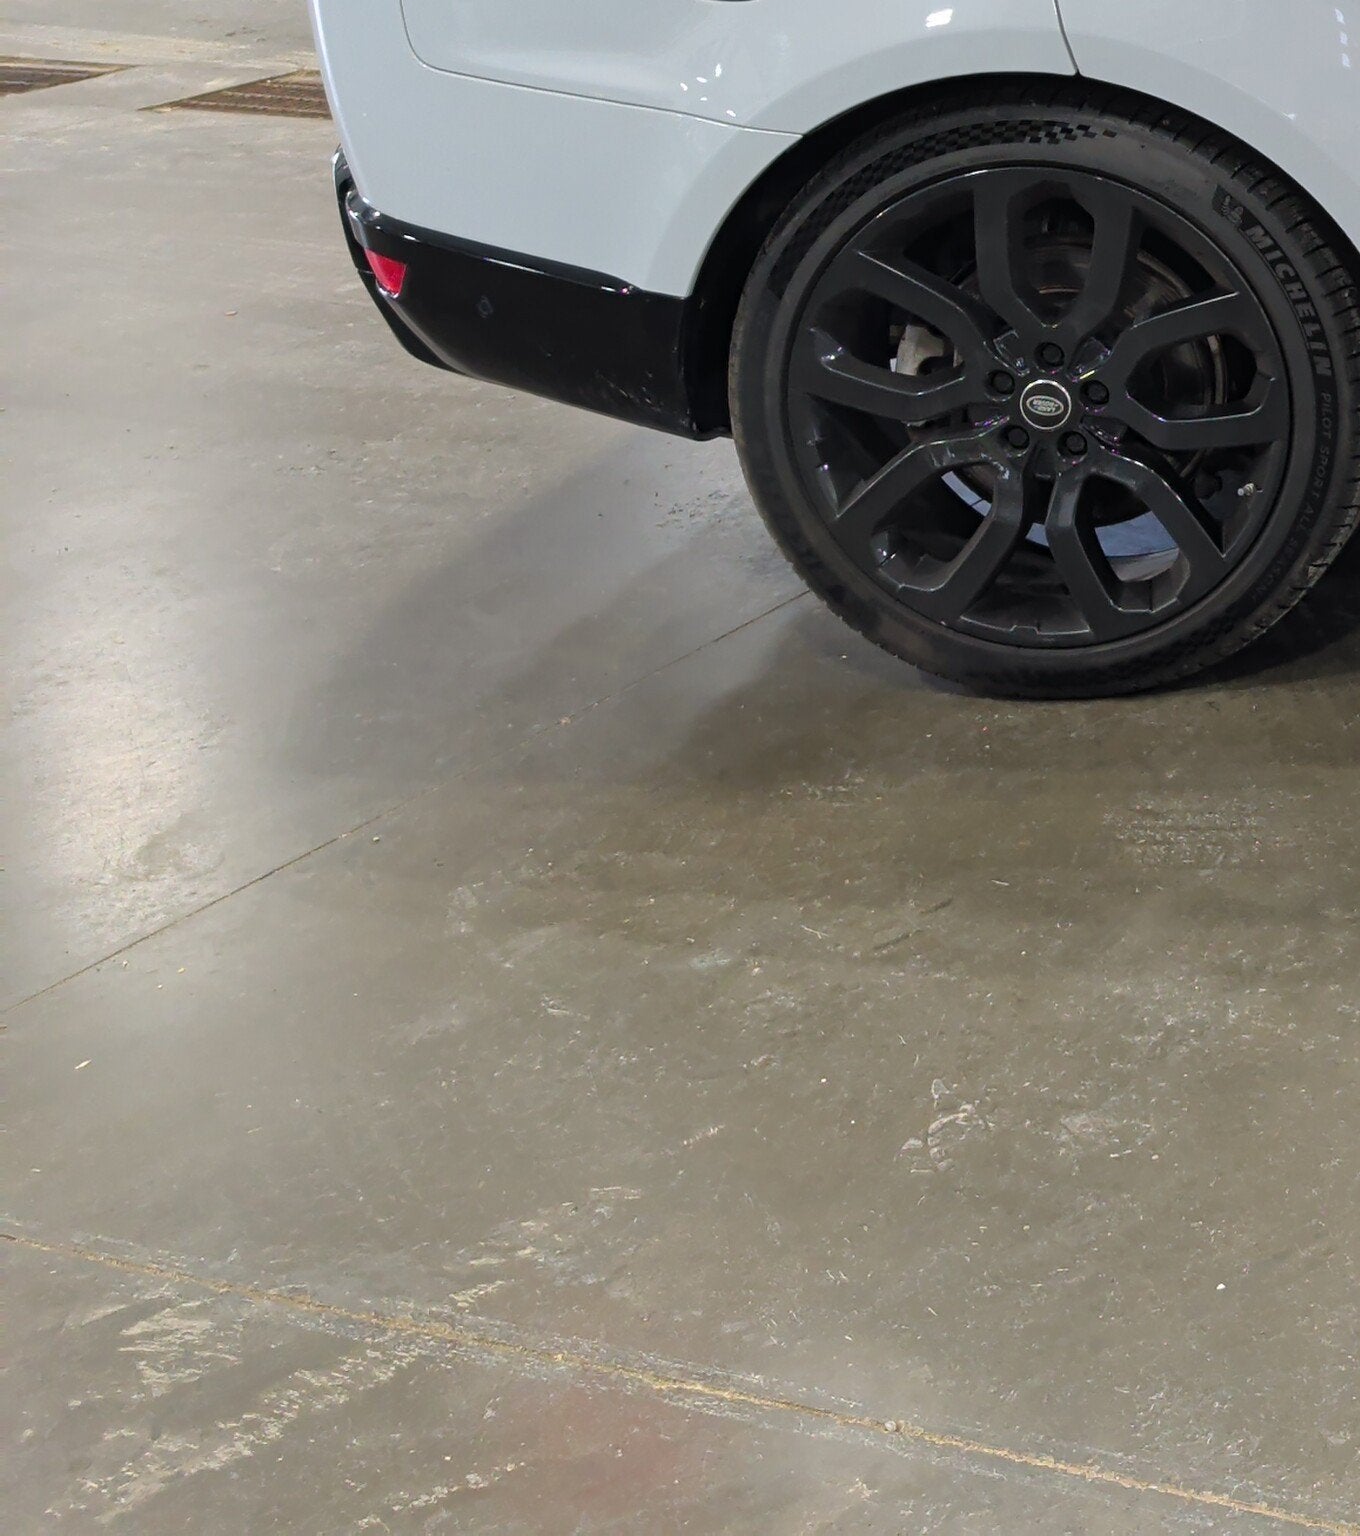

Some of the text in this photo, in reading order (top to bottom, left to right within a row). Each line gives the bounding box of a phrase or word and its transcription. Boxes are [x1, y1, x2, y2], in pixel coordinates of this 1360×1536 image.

[1245, 223, 1333, 377] MICHELIN
[1320, 391, 1333, 440] PILOT
[1312, 445, 1330, 500] SPORT
